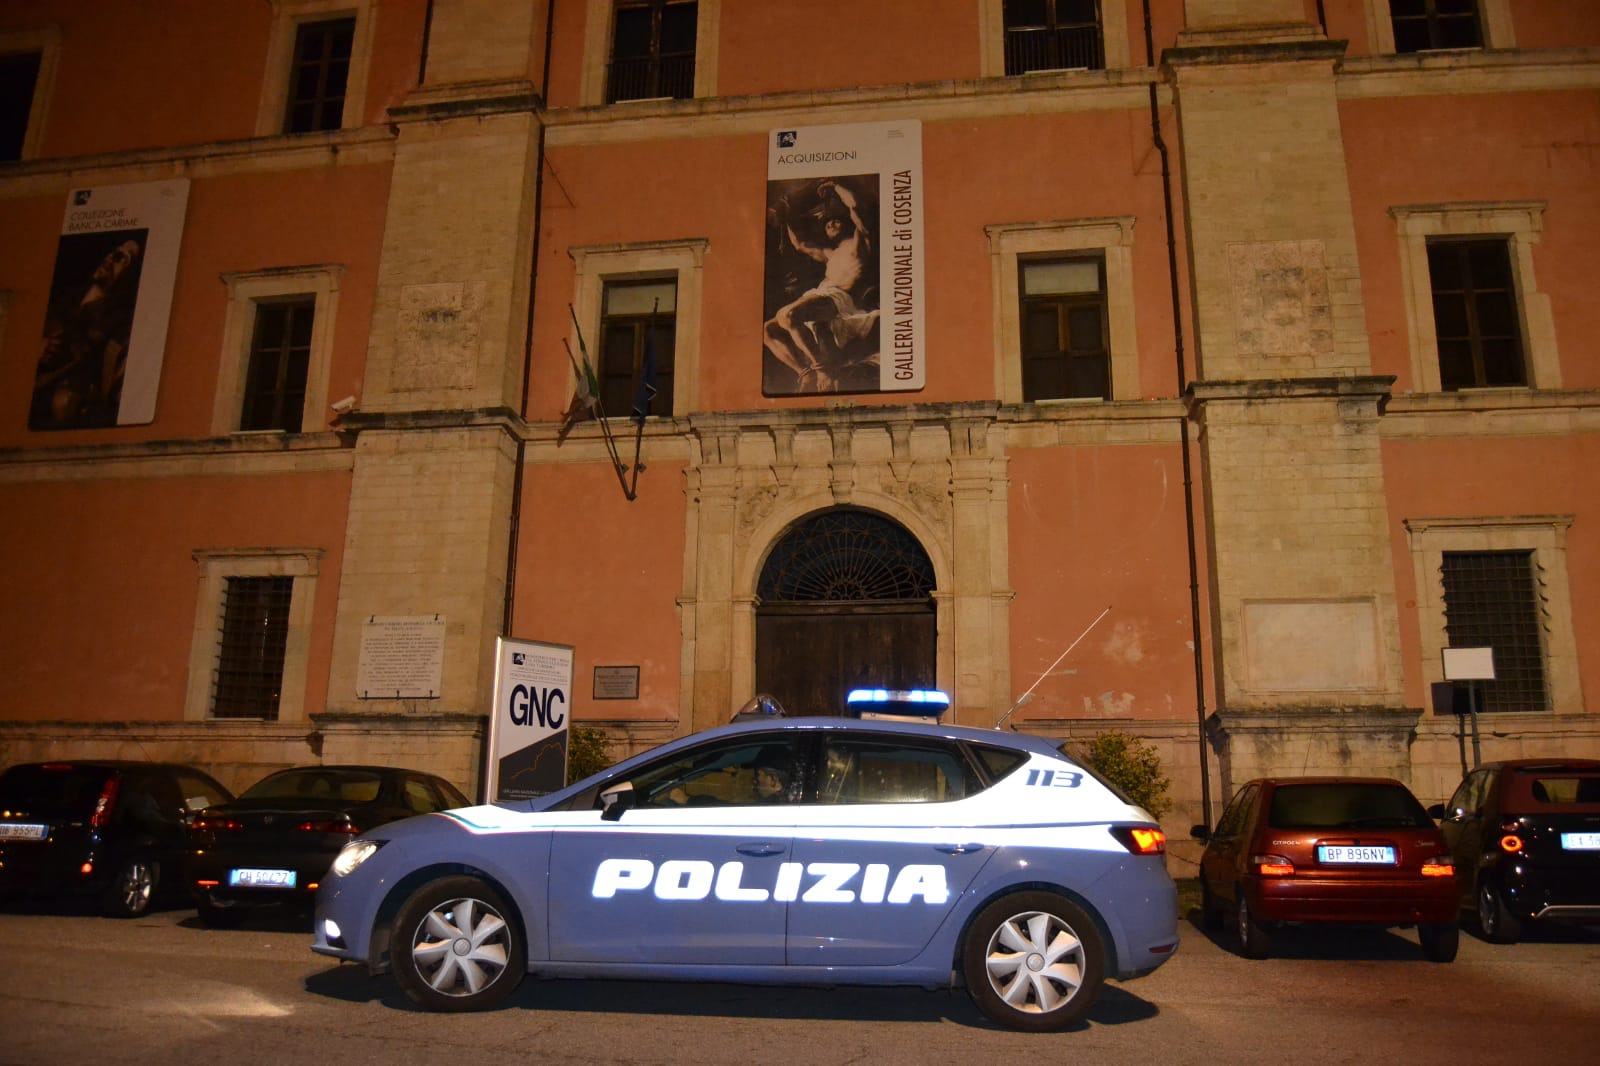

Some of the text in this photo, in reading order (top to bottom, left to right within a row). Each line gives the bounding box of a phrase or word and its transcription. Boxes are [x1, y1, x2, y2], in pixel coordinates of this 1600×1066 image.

[777, 151, 857, 165] ACQUISIZIONI
[892, 170, 914, 381] GALLERIA NAZIONALE di COSENZA
[509, 684, 565, 730] GNC
[1026, 769, 1084, 788] 113
[1328, 848, 1384, 860] BP 896NV
[592, 859, 949, 904] POLIZIA
